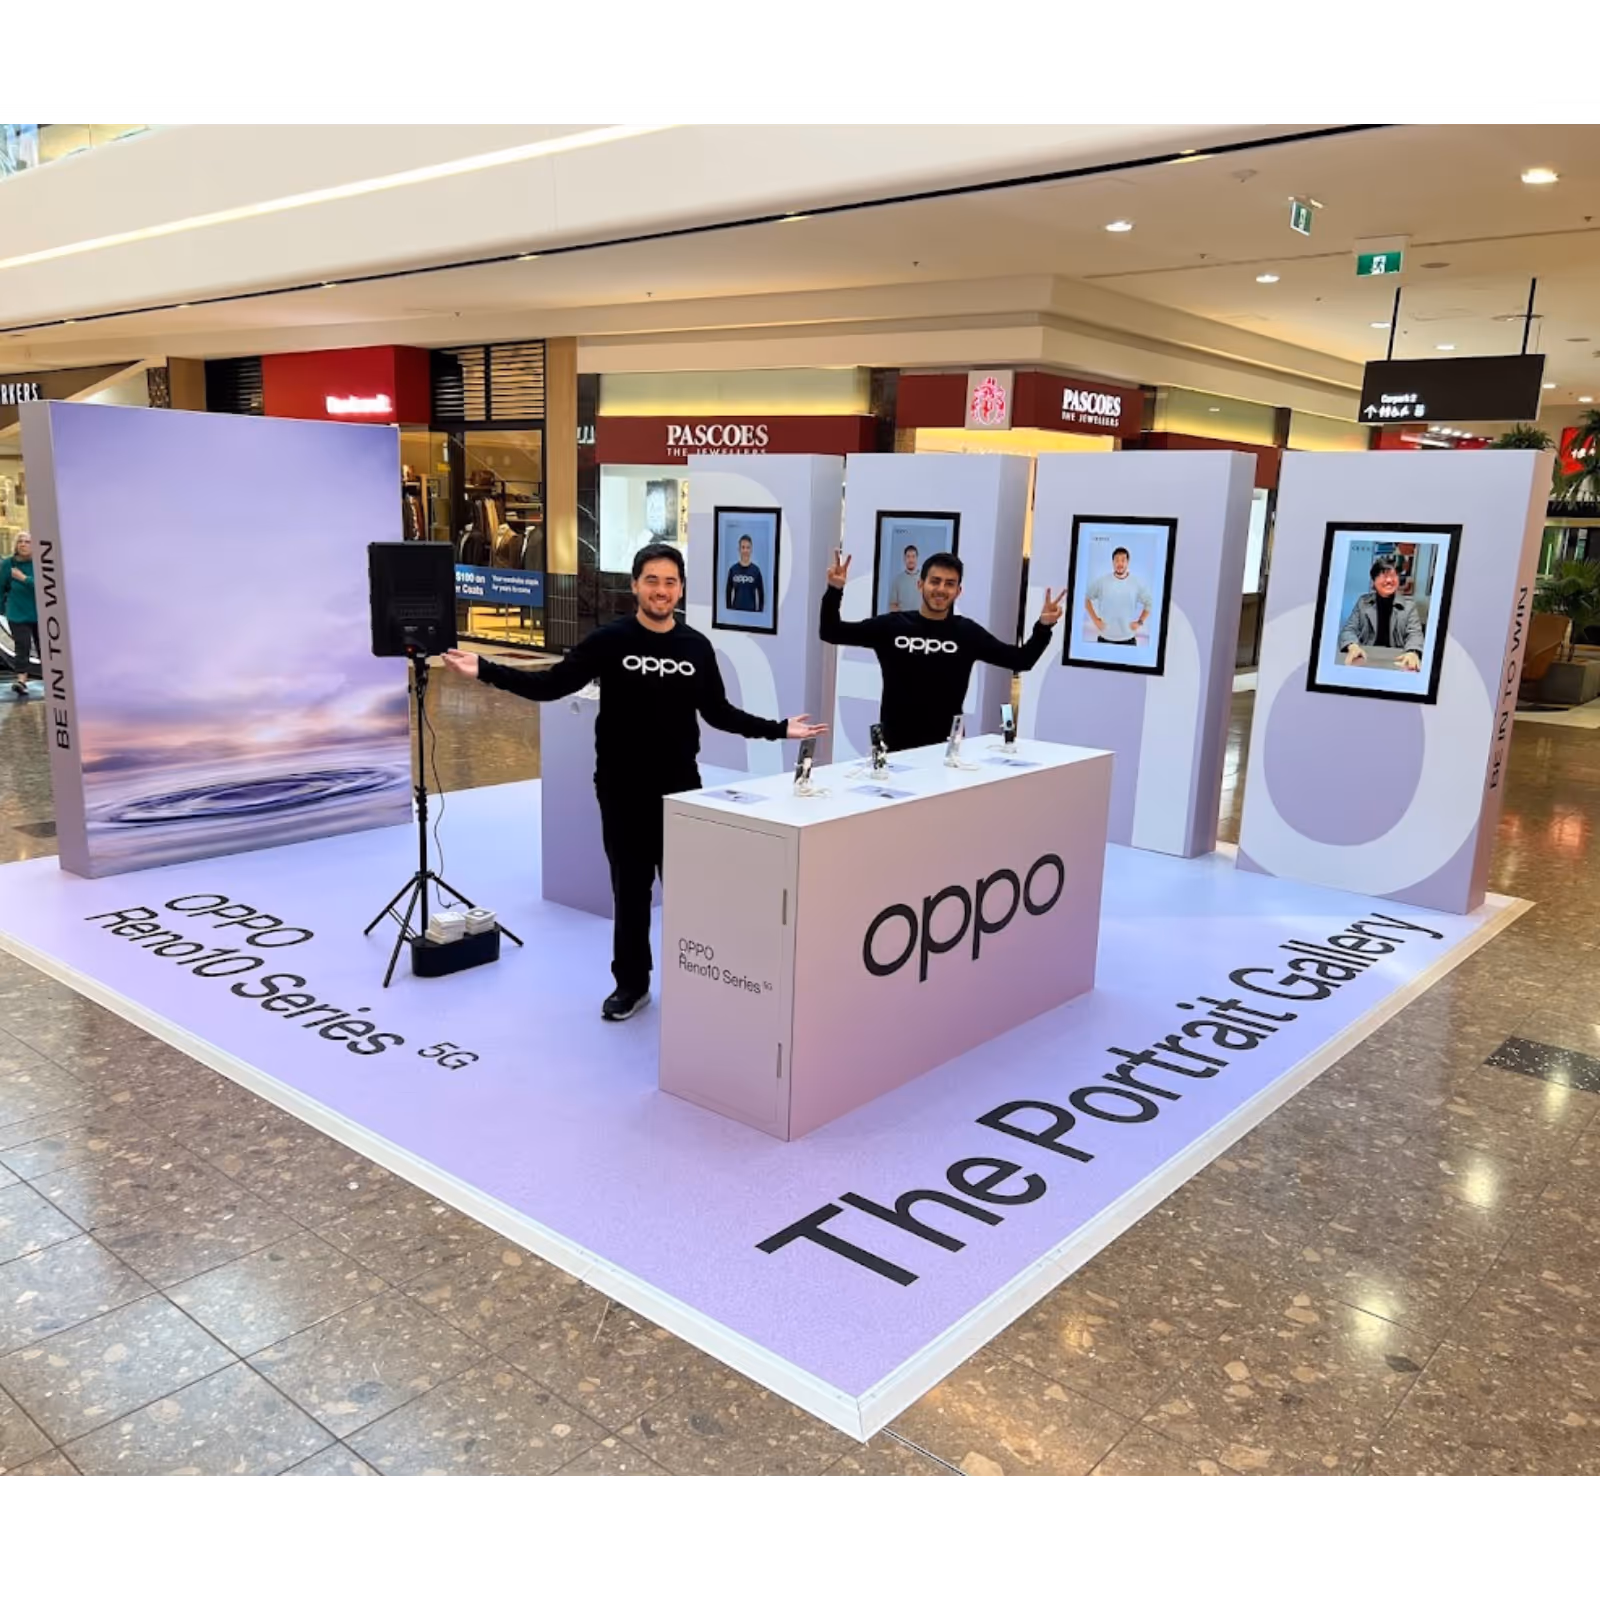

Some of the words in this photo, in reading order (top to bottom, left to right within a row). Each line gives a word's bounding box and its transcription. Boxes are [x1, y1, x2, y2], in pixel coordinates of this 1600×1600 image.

[1061, 411, 1076, 422] THE
[1079, 413, 1119, 427] JEWELLERS
[1062, 387, 1121, 417] PASCOES
[666, 424, 770, 447] PASCOES
[667, 447, 689, 457] THE
[40, 540, 58, 608] WIN
[46, 616, 61, 661] TO
[1510, 586, 1528, 654] WIN
[622, 654, 696, 678] oppo
[893, 635, 959, 655] oppo
[51, 668, 66, 700] IN
[1502, 659, 1517, 705] TO
[54, 708, 70, 750] BE
[1497, 710, 1510, 742] IN
[165, 893, 315, 949] OPPO
[862, 853, 1066, 983] oppo
[678, 937, 715, 961] OPPO
[84, 906, 265, 978] Reno10
[230, 973, 405, 1056] Series
[417, 1041, 480, 1071] 5G
[678, 952, 721, 981] Reno10
[722, 969, 762, 994] Series
[754, 1155, 1048, 1288] The
[974, 994, 1299, 1164] Portrait
[1227, 912, 1445, 1004] Gallery
